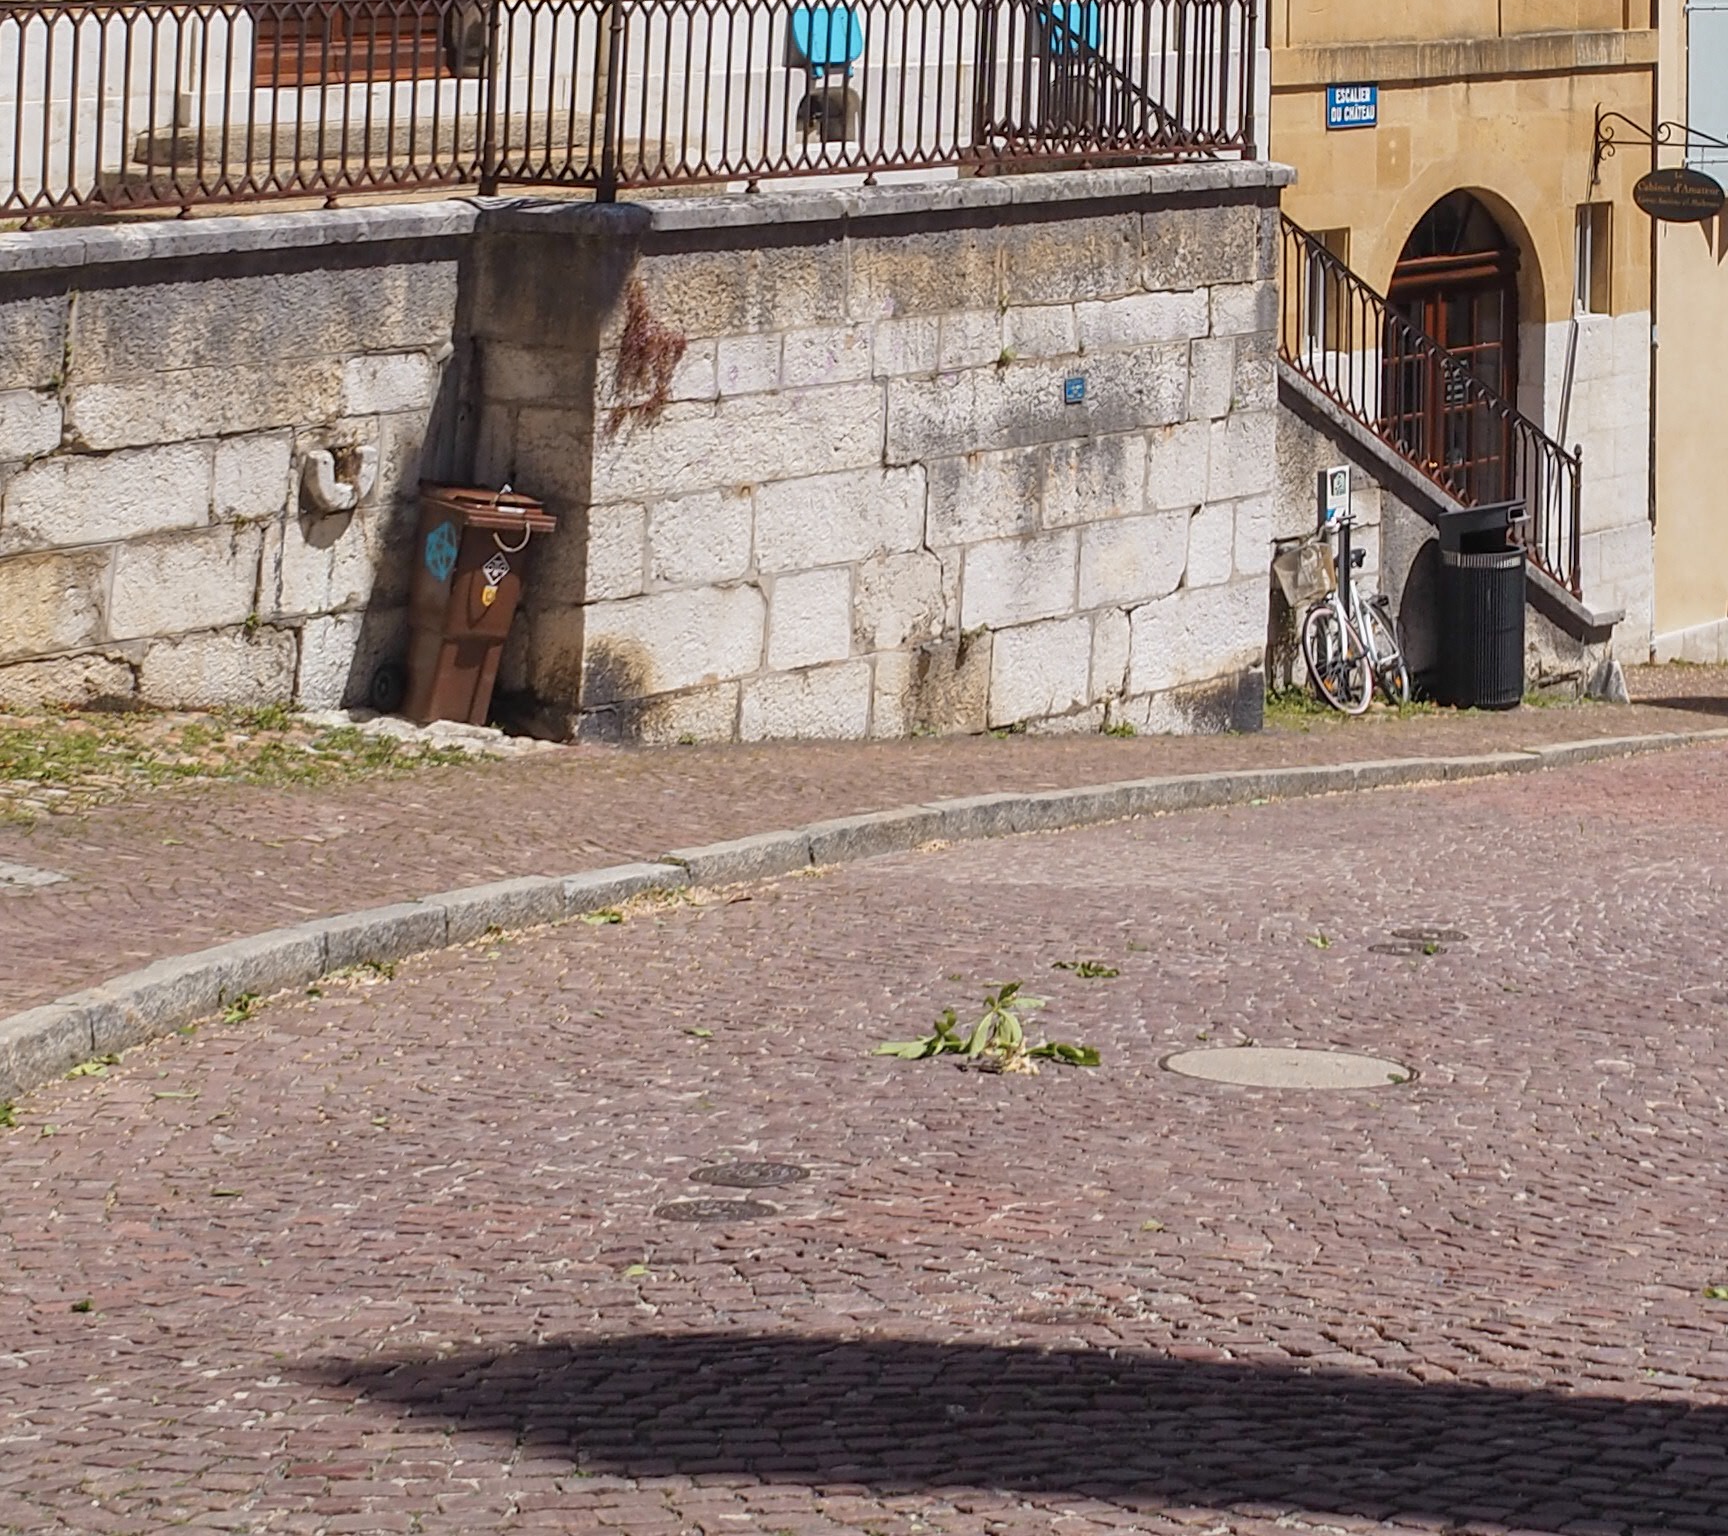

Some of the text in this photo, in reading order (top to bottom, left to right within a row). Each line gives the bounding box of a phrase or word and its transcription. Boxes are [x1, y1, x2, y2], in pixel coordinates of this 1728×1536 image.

[1335, 87, 1371, 104] ESCALIER
[1330, 103, 1375, 122] DU CHÂTEAU
